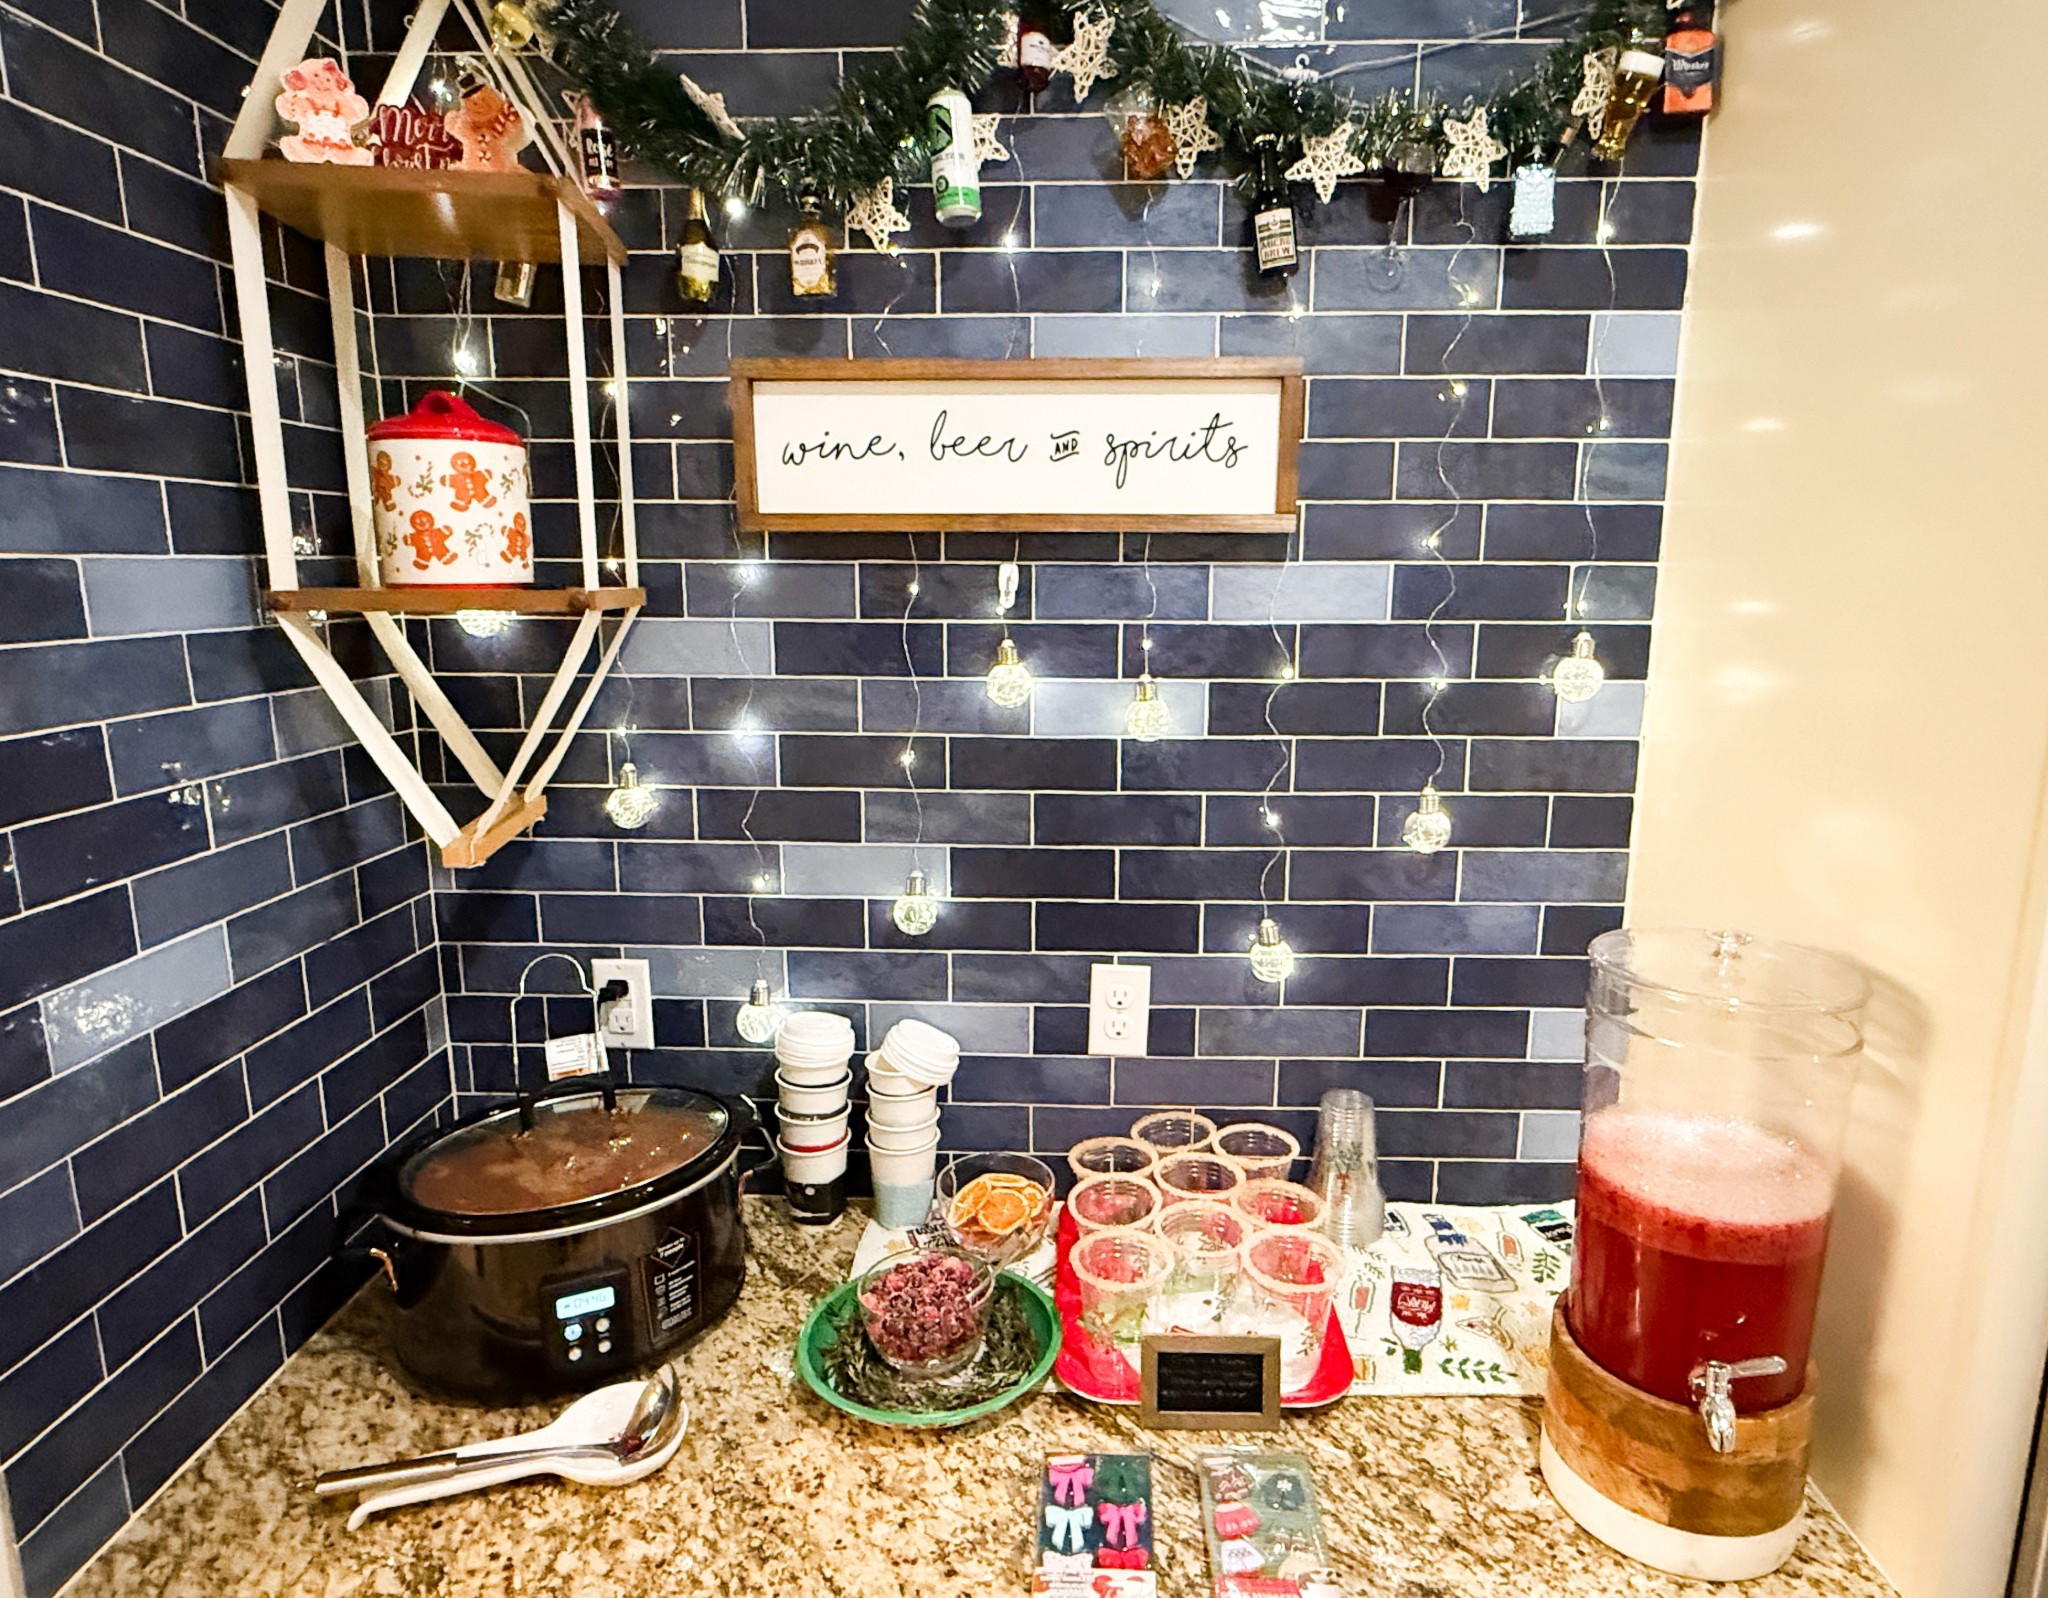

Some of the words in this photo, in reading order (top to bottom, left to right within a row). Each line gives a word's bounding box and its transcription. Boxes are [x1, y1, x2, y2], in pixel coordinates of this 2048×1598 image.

[1263, 246, 1291, 259] BREW
[782, 431, 905, 466] wine,
[930, 409, 1029, 463] beer
[1104, 412, 1249, 490] spirits
